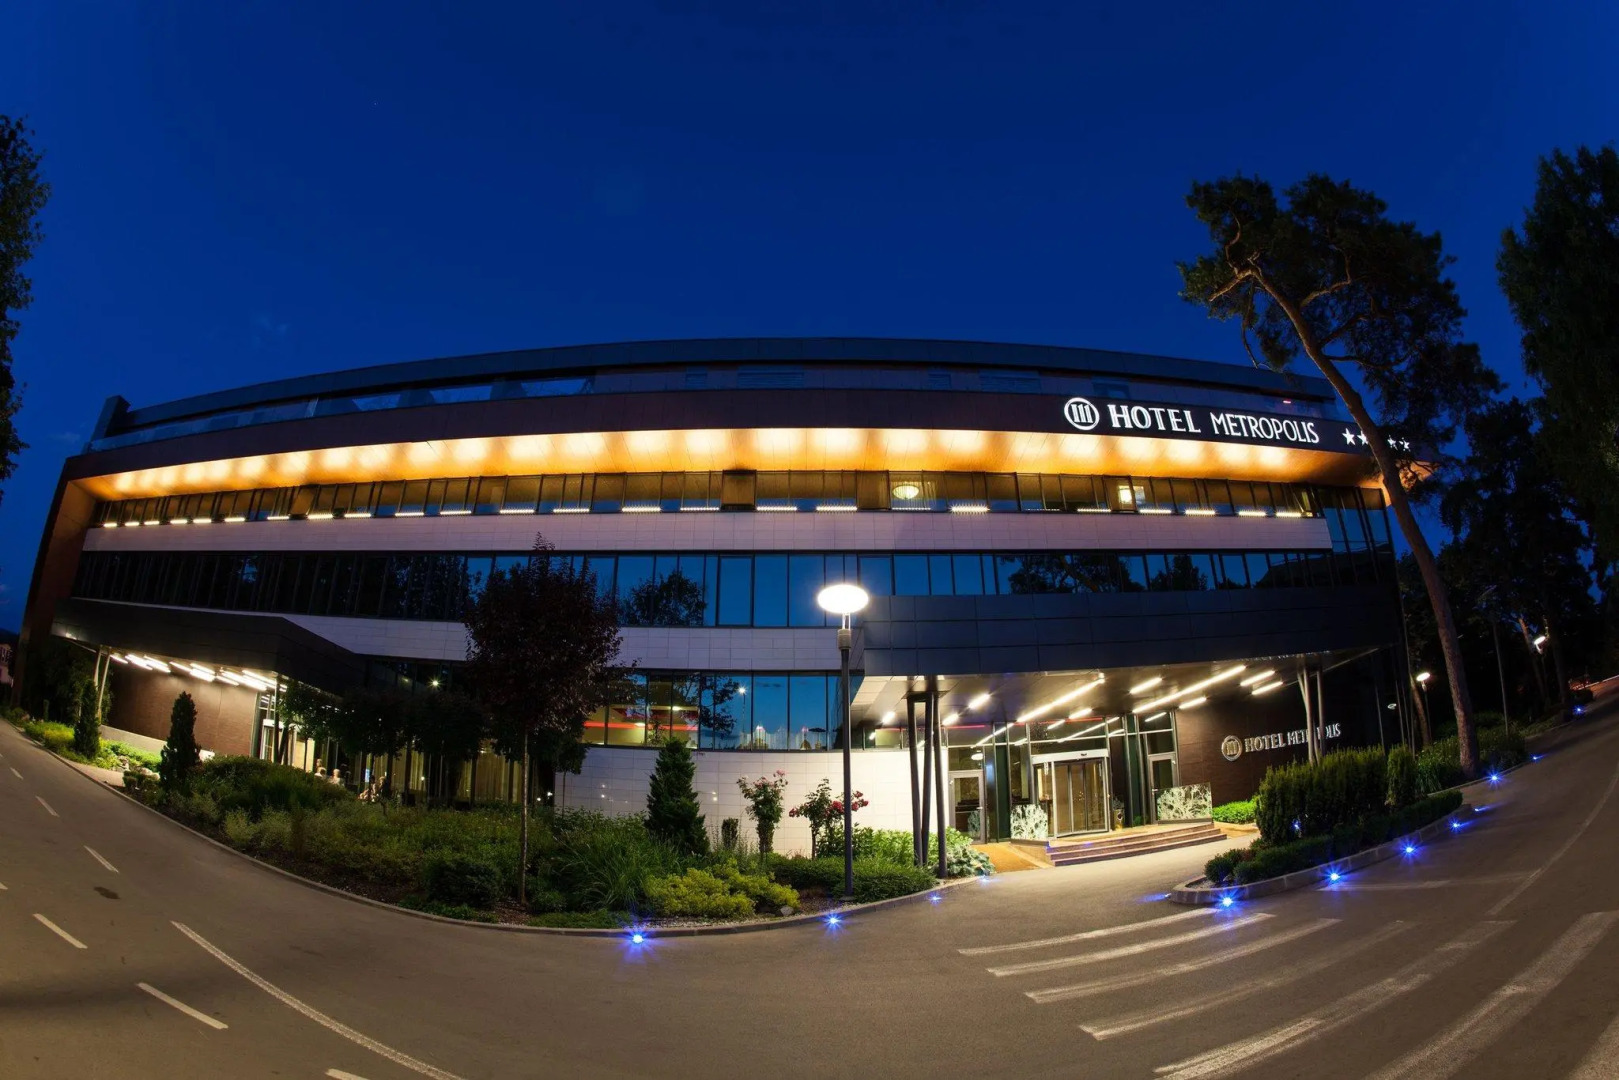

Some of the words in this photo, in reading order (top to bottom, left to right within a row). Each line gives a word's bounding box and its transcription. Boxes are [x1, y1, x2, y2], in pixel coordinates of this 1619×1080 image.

[1107, 404, 1201, 433] HOTEL
[1209, 412, 1319, 444] METROPOLIS
[1244, 732, 1286, 753] HOTEL
[1287, 723, 1341, 745] METLIS
